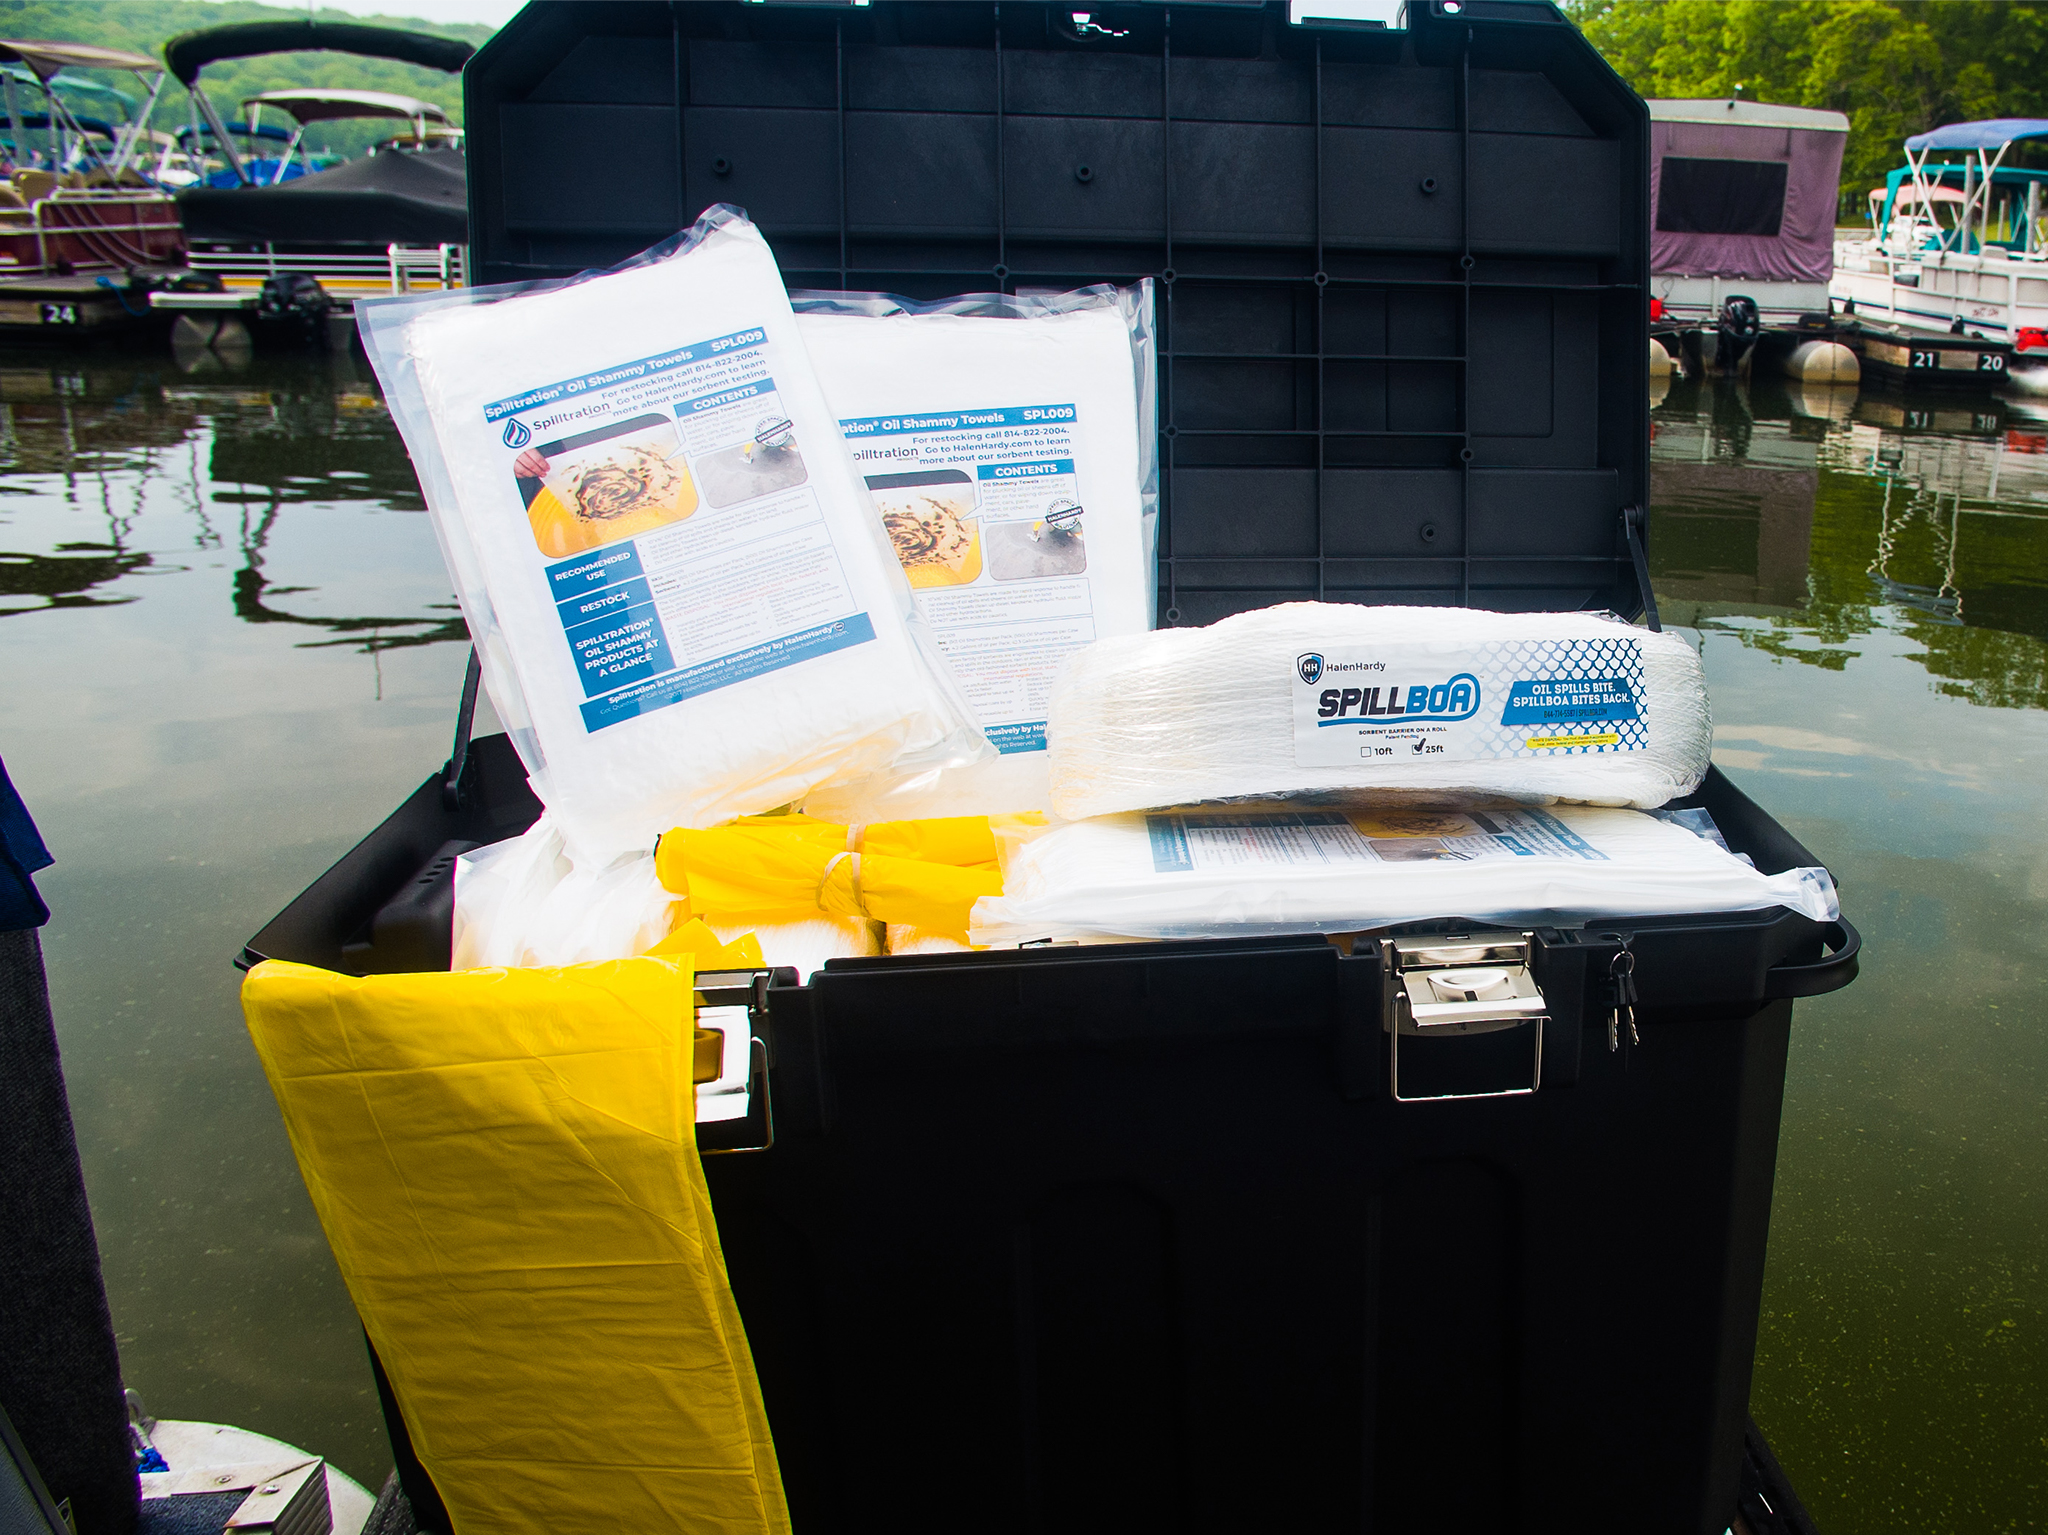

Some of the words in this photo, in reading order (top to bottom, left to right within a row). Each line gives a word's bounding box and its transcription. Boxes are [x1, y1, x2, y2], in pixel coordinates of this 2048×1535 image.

[46, 305, 76, 324] 24
[566, 380, 586, 393] Oil
[587, 363, 647, 387] Shammy
[646, 350, 694, 369] Towels
[711, 330, 764, 352] SPL009
[1914, 352, 1934, 368] 21
[1982, 355, 2004, 371] 20
[601, 389, 618, 399] For
[620, 374, 674, 393] restocking
[675, 369, 693, 377] call
[695, 349, 762, 372] 814-822-2004.
[616, 396, 630, 405] Go
[644, 369, 726, 396] HalenHardy.com
[728, 365, 739, 374] to
[740, 359, 766, 370] learn
[612, 406, 639, 416] more
[640, 396, 670, 408] about
[672, 390, 689, 400] our
[691, 379, 729, 393] sorbent
[731, 367, 770, 381] testing.
[692, 386, 758, 411] CONTENTS
[532, 401, 611, 431] Spilltration
[881, 420, 900, 430] Oil
[902, 415, 958, 429] Shammy
[960, 412, 1004, 424] Towels
[1023, 407, 1074, 421] SPL009
[931, 432, 982, 443] restocking
[1004, 426, 1069, 437] 814-822-2004.
[953, 439, 1032, 451] HalenHardy.com
[1046, 436, 1070, 444] learn
[946, 454, 975, 462] about
[996, 450, 1033, 458] sorbent
[1035, 447, 1072, 456] testing.
[994, 464, 1057, 477] CONTENTS
[554, 552, 631, 580] RECOMMENDED
[586, 570, 606, 580] USE
[580, 592, 630, 612] RESTOCK
[584, 647, 604, 657] OIL
[605, 631, 653, 650] SHAMMY
[584, 645, 644, 669] PRODUCTS
[644, 640, 660, 649] AT
[607, 683, 656, 703] Spilltration
[656, 679, 664, 687] is
[665, 660, 725, 683] manufactured
[726, 645, 772, 663] exclusively
[772, 641, 784, 650] by
[784, 625, 833, 645] HalenHardy
[598, 668, 609, 678] A
[610, 653, 654, 673] GLANCE
[1303, 663, 1318, 672] HH
[1326, 662, 1386, 672] HalenHardy
[1532, 684, 1552, 695] OIL
[1554, 683, 1590, 694] SPILLS
[1592, 682, 1616, 692] BITE.
[1318, 683, 1472, 718] SPILLBOA
[1513, 696, 1570, 708] SPILLBOA
[1572, 694, 1600, 705] BITES
[1602, 692, 1630, 704] BACK.
[1021, 725, 1031, 733] by
[1374, 748, 1393, 756] 10ft
[1426, 745, 1444, 753] 25ft
